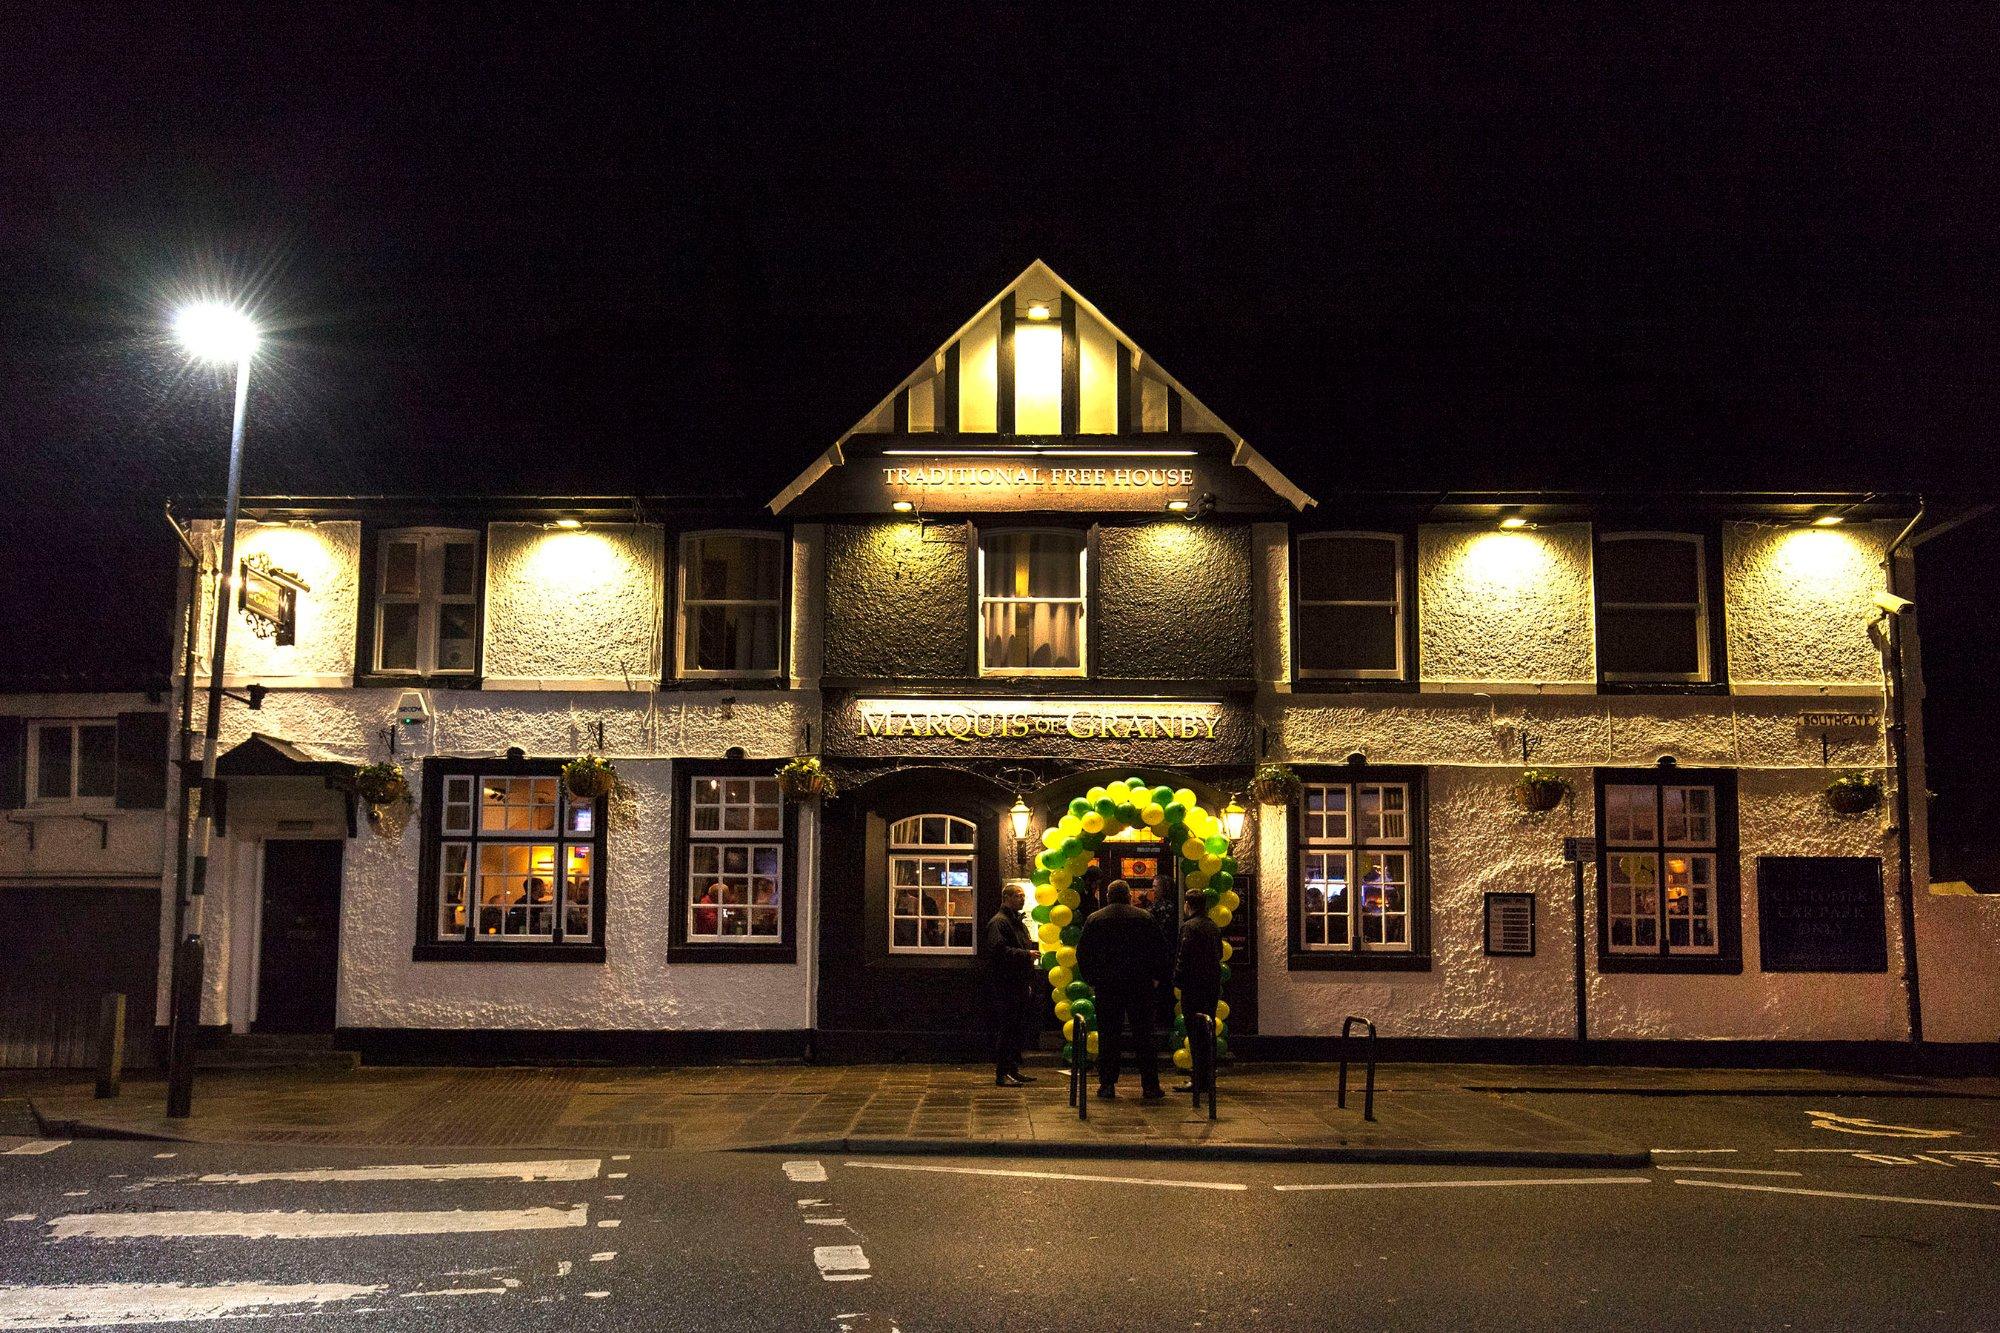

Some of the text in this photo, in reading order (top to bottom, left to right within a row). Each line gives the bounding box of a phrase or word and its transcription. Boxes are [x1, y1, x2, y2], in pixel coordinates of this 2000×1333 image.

[882, 467, 1193, 487] TRADITIONAL FREE HOUSE
[858, 707, 1030, 742] MARQUIS
[1065, 710, 1222, 740] GRANBY
[1803, 715, 1871, 726] SOUTHGATE
